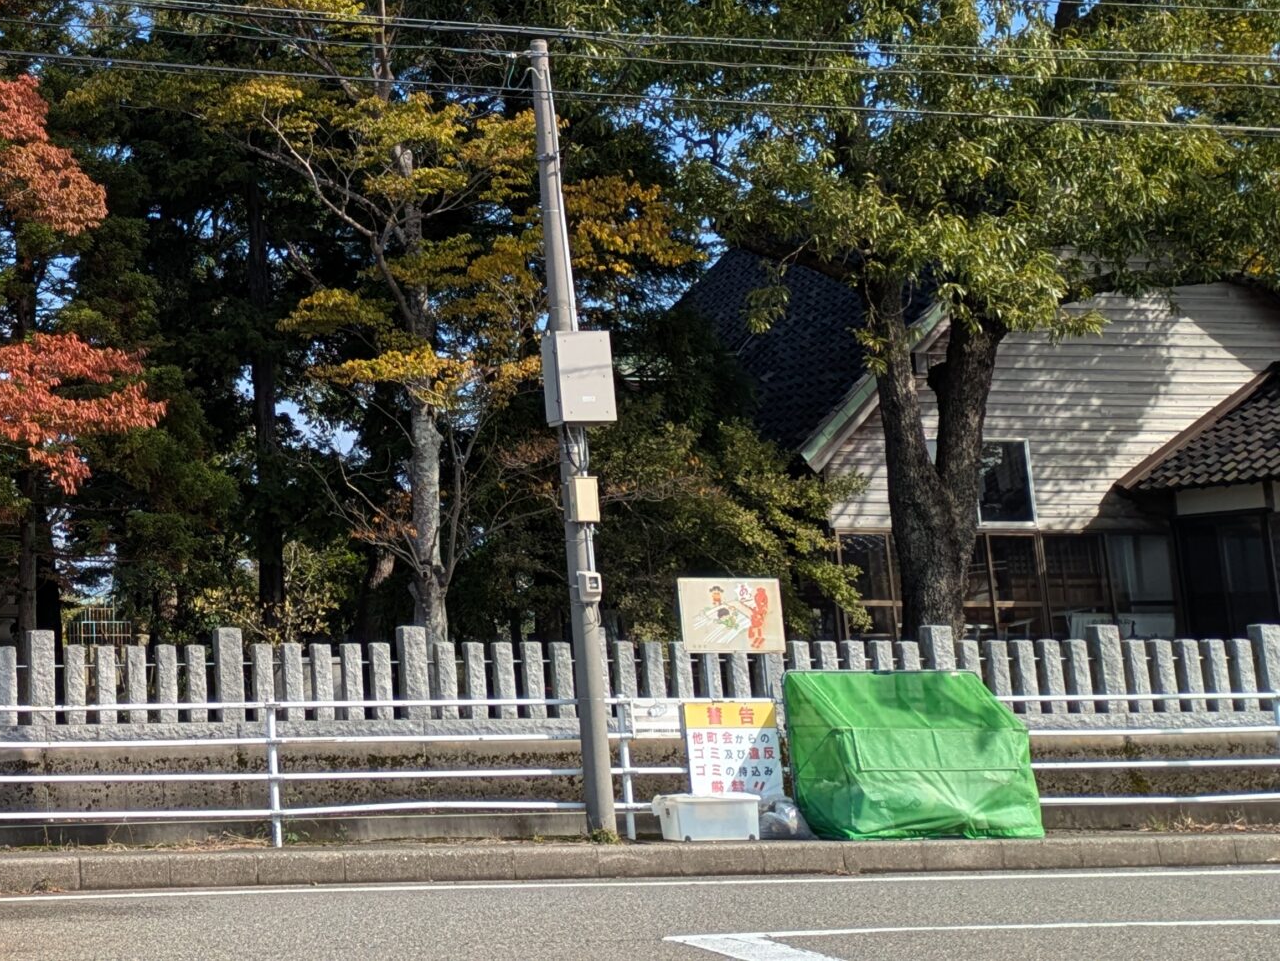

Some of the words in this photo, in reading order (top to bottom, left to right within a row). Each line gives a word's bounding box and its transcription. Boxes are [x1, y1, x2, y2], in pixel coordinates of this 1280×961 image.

[707, 706, 755, 725] 警告
[692, 731, 770, 745] 他町会からの
[694, 746, 776, 761] ゴミ及び違反
[696, 763, 773, 777] ゴミの持込み
